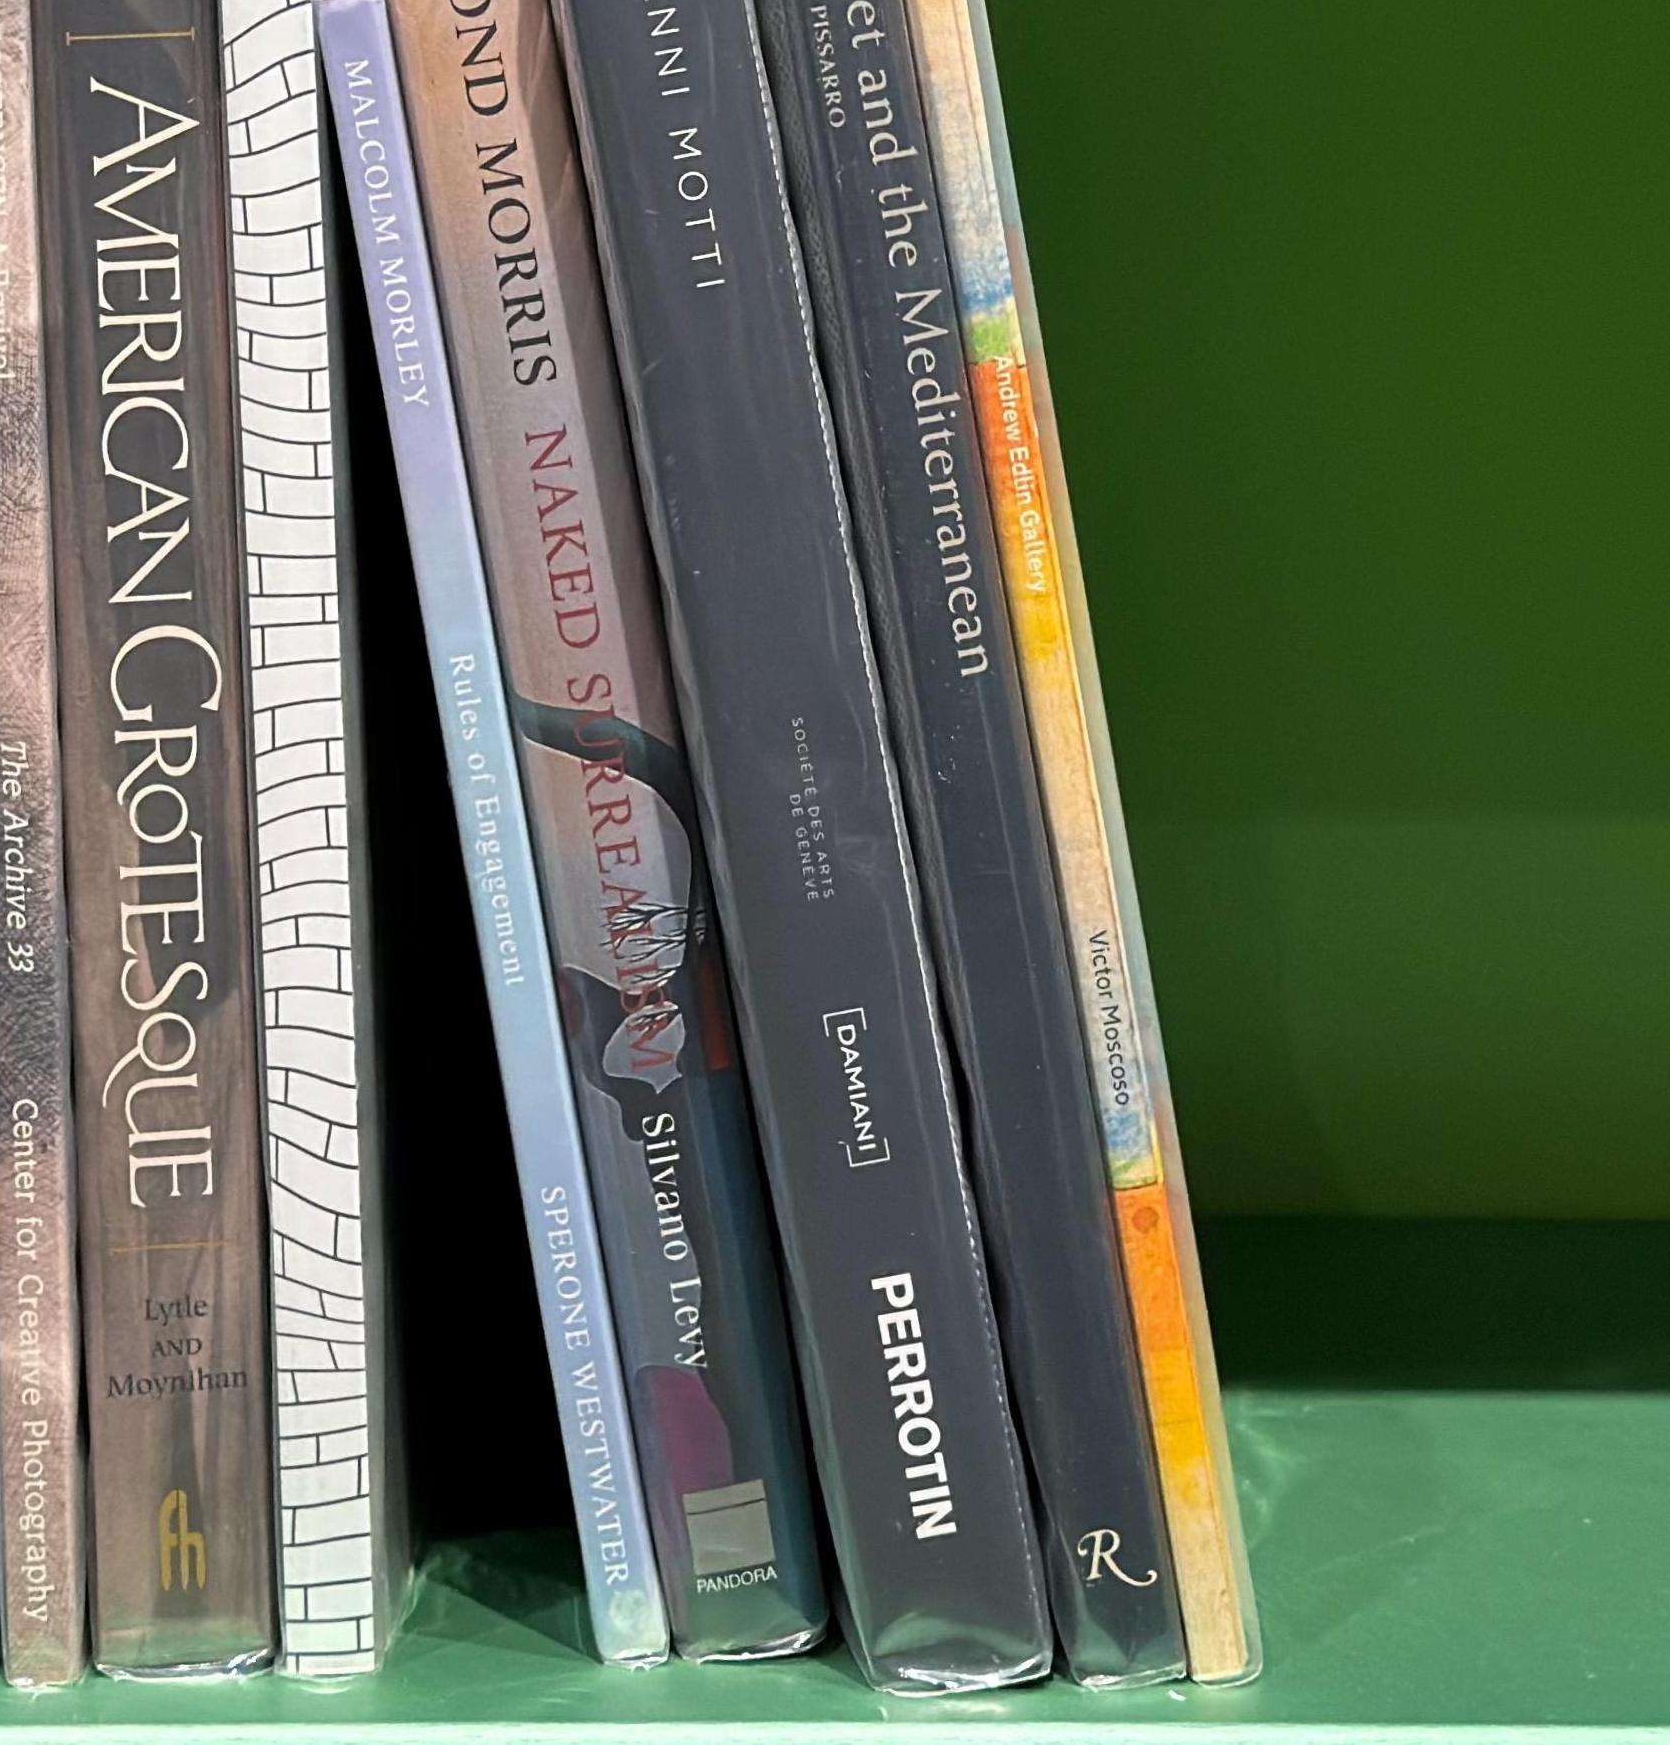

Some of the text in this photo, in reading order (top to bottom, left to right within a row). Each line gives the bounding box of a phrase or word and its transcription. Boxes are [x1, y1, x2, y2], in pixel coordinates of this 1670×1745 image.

[810, 5, 847, 130] PISSARRO
[856, 69, 918, 167] and
[342, 59, 429, 408] MALCOLM MORLEY
[667, 127, 726, 290] MOTTI
[877, 182, 928, 269] the
[895, 287, 995, 679] Mediterranean
[993, 355, 1050, 594] Andrew Edlin Gallery
[89, 75, 223, 1208] AMERICAN GROTESQUE
[448, 653, 526, 987] Rules of Engagement
[474, 139, 557, 387] MORRIS
[524, 424, 602, 650] NAKED
[566, 673, 673, 1073] SURREALISM
[639, 1113, 688, 1261] Silvano
[666, 1277, 712, 1370] Levy
[789, 794, 804, 818] DE
[791, 717, 834, 899] SOCIÉTÉ DES ARTS
[0, 741, 34, 973] The Archive 33
[1087, 929, 1134, 1106] Victor Moscoso
[10, 1098, 54, 1622] Center for Creative Photography
[106, 1367, 249, 1400] Moynihan
[145, 1294, 209, 1327] Lytle
[151, 1337, 203, 1357] AND
[539, 1186, 629, 1587] SPERONE WESTWATER
[870, 1272, 958, 1541] PERROTIN
[695, 1568, 778, 1595] PANDORA
